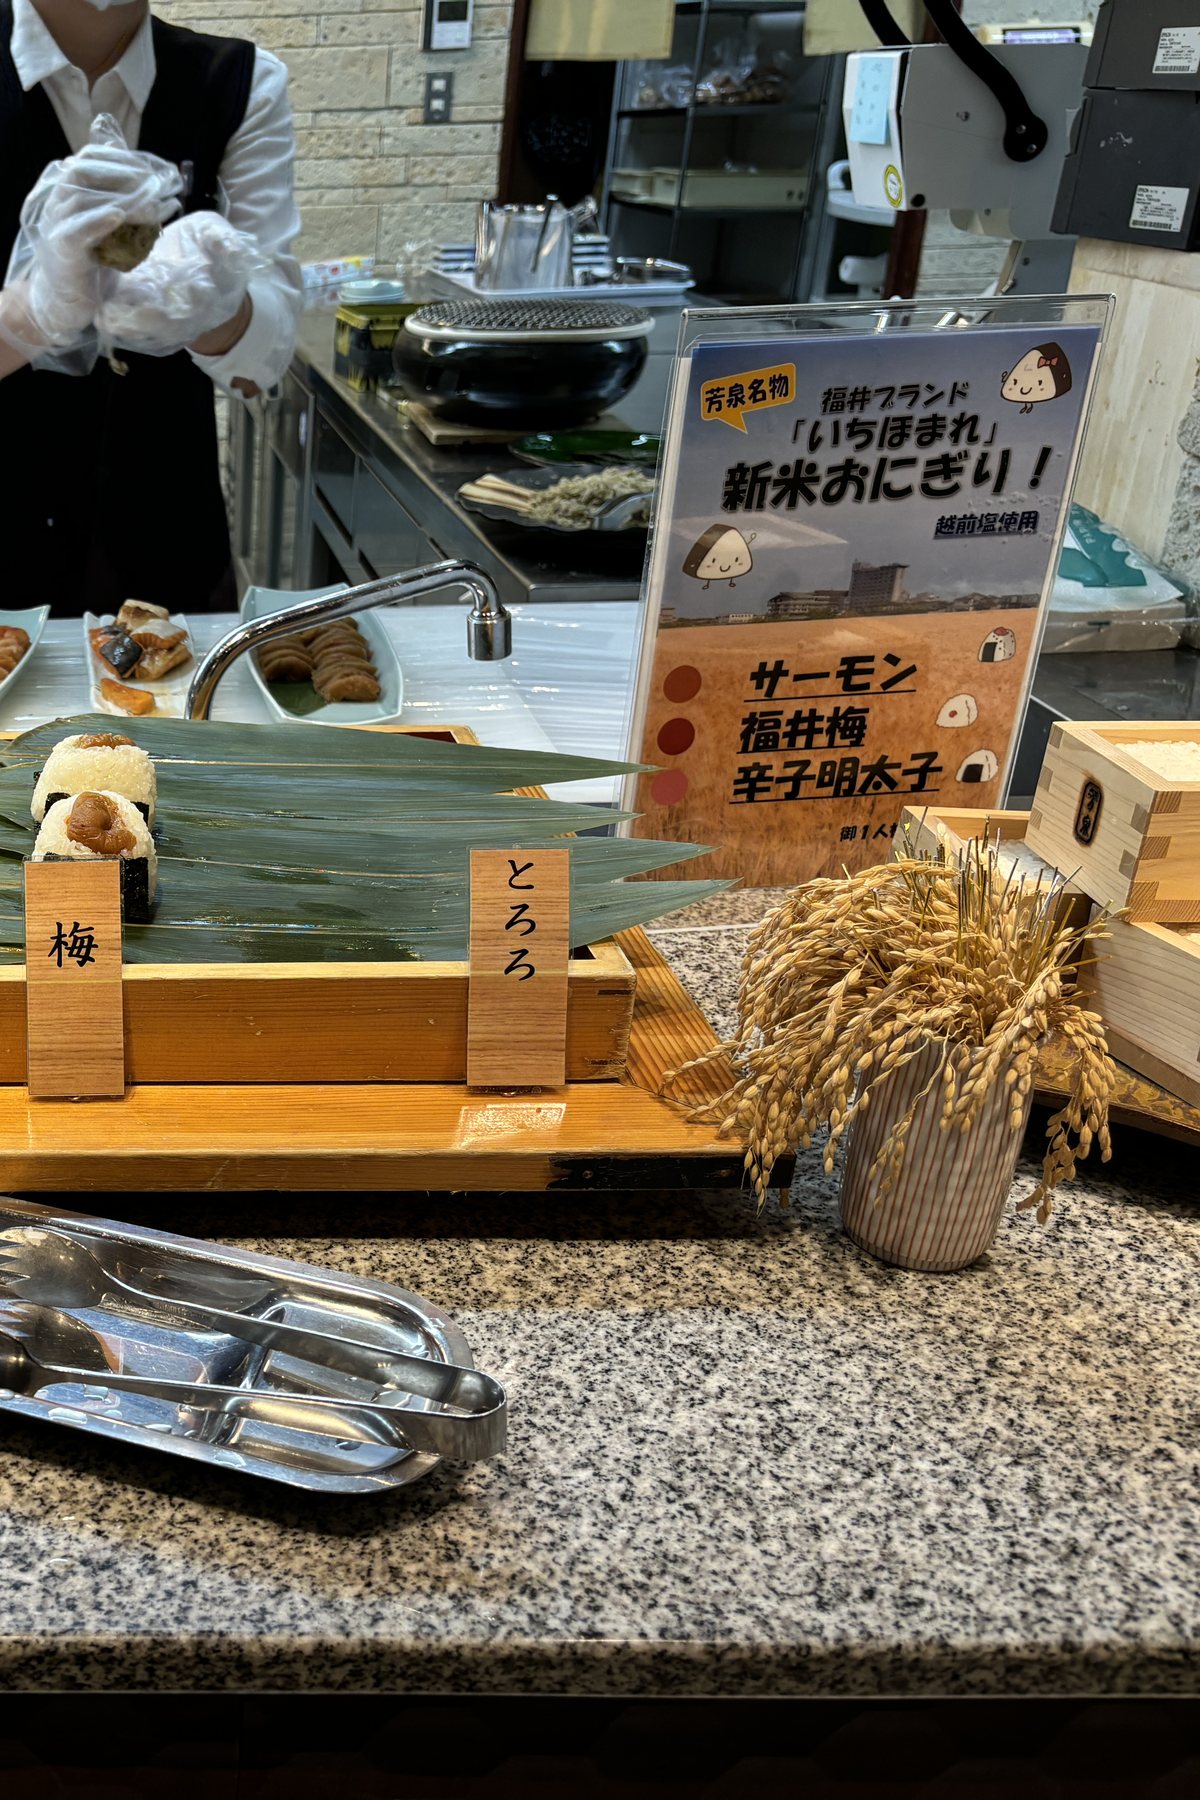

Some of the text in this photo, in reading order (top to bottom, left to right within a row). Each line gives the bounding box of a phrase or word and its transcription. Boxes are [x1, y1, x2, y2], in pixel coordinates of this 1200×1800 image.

[705, 373, 789, 413] 芳泉名物
[821, 381, 969, 414] 福井ブランド
[791, 411, 997, 452] 「いちほまれ」
[721, 446, 1053, 512] 新米おにぎり！
[934, 510, 1039, 537] 越前塩使用
[750, 653, 918, 698] サーモン
[739, 706, 870, 753] 福井梅
[732, 751, 943, 803] 辛子明太子
[504, 859, 537, 981] とろろ
[47, 921, 100, 969] 梅
